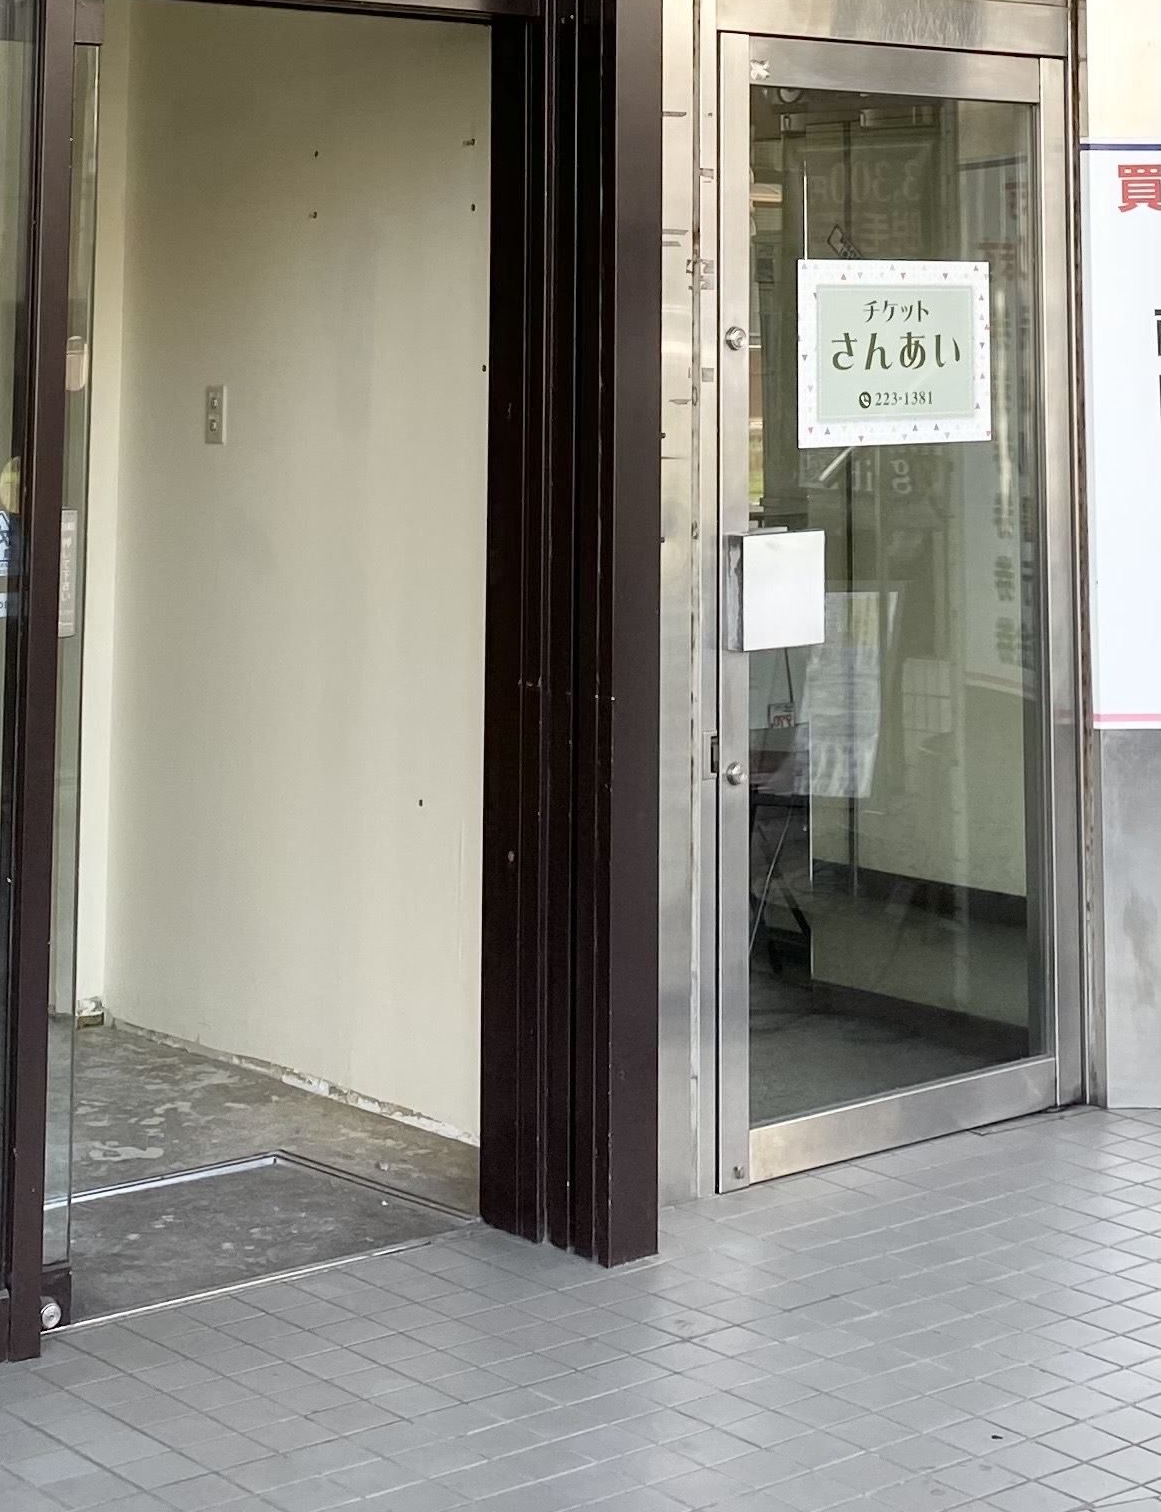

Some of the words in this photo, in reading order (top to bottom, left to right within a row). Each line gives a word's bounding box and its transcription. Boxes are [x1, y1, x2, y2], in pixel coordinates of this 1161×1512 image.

[862, 300, 930, 323] チケット
[831, 331, 962, 371] さんあい
[874, 390, 933, 407] 223-1381
